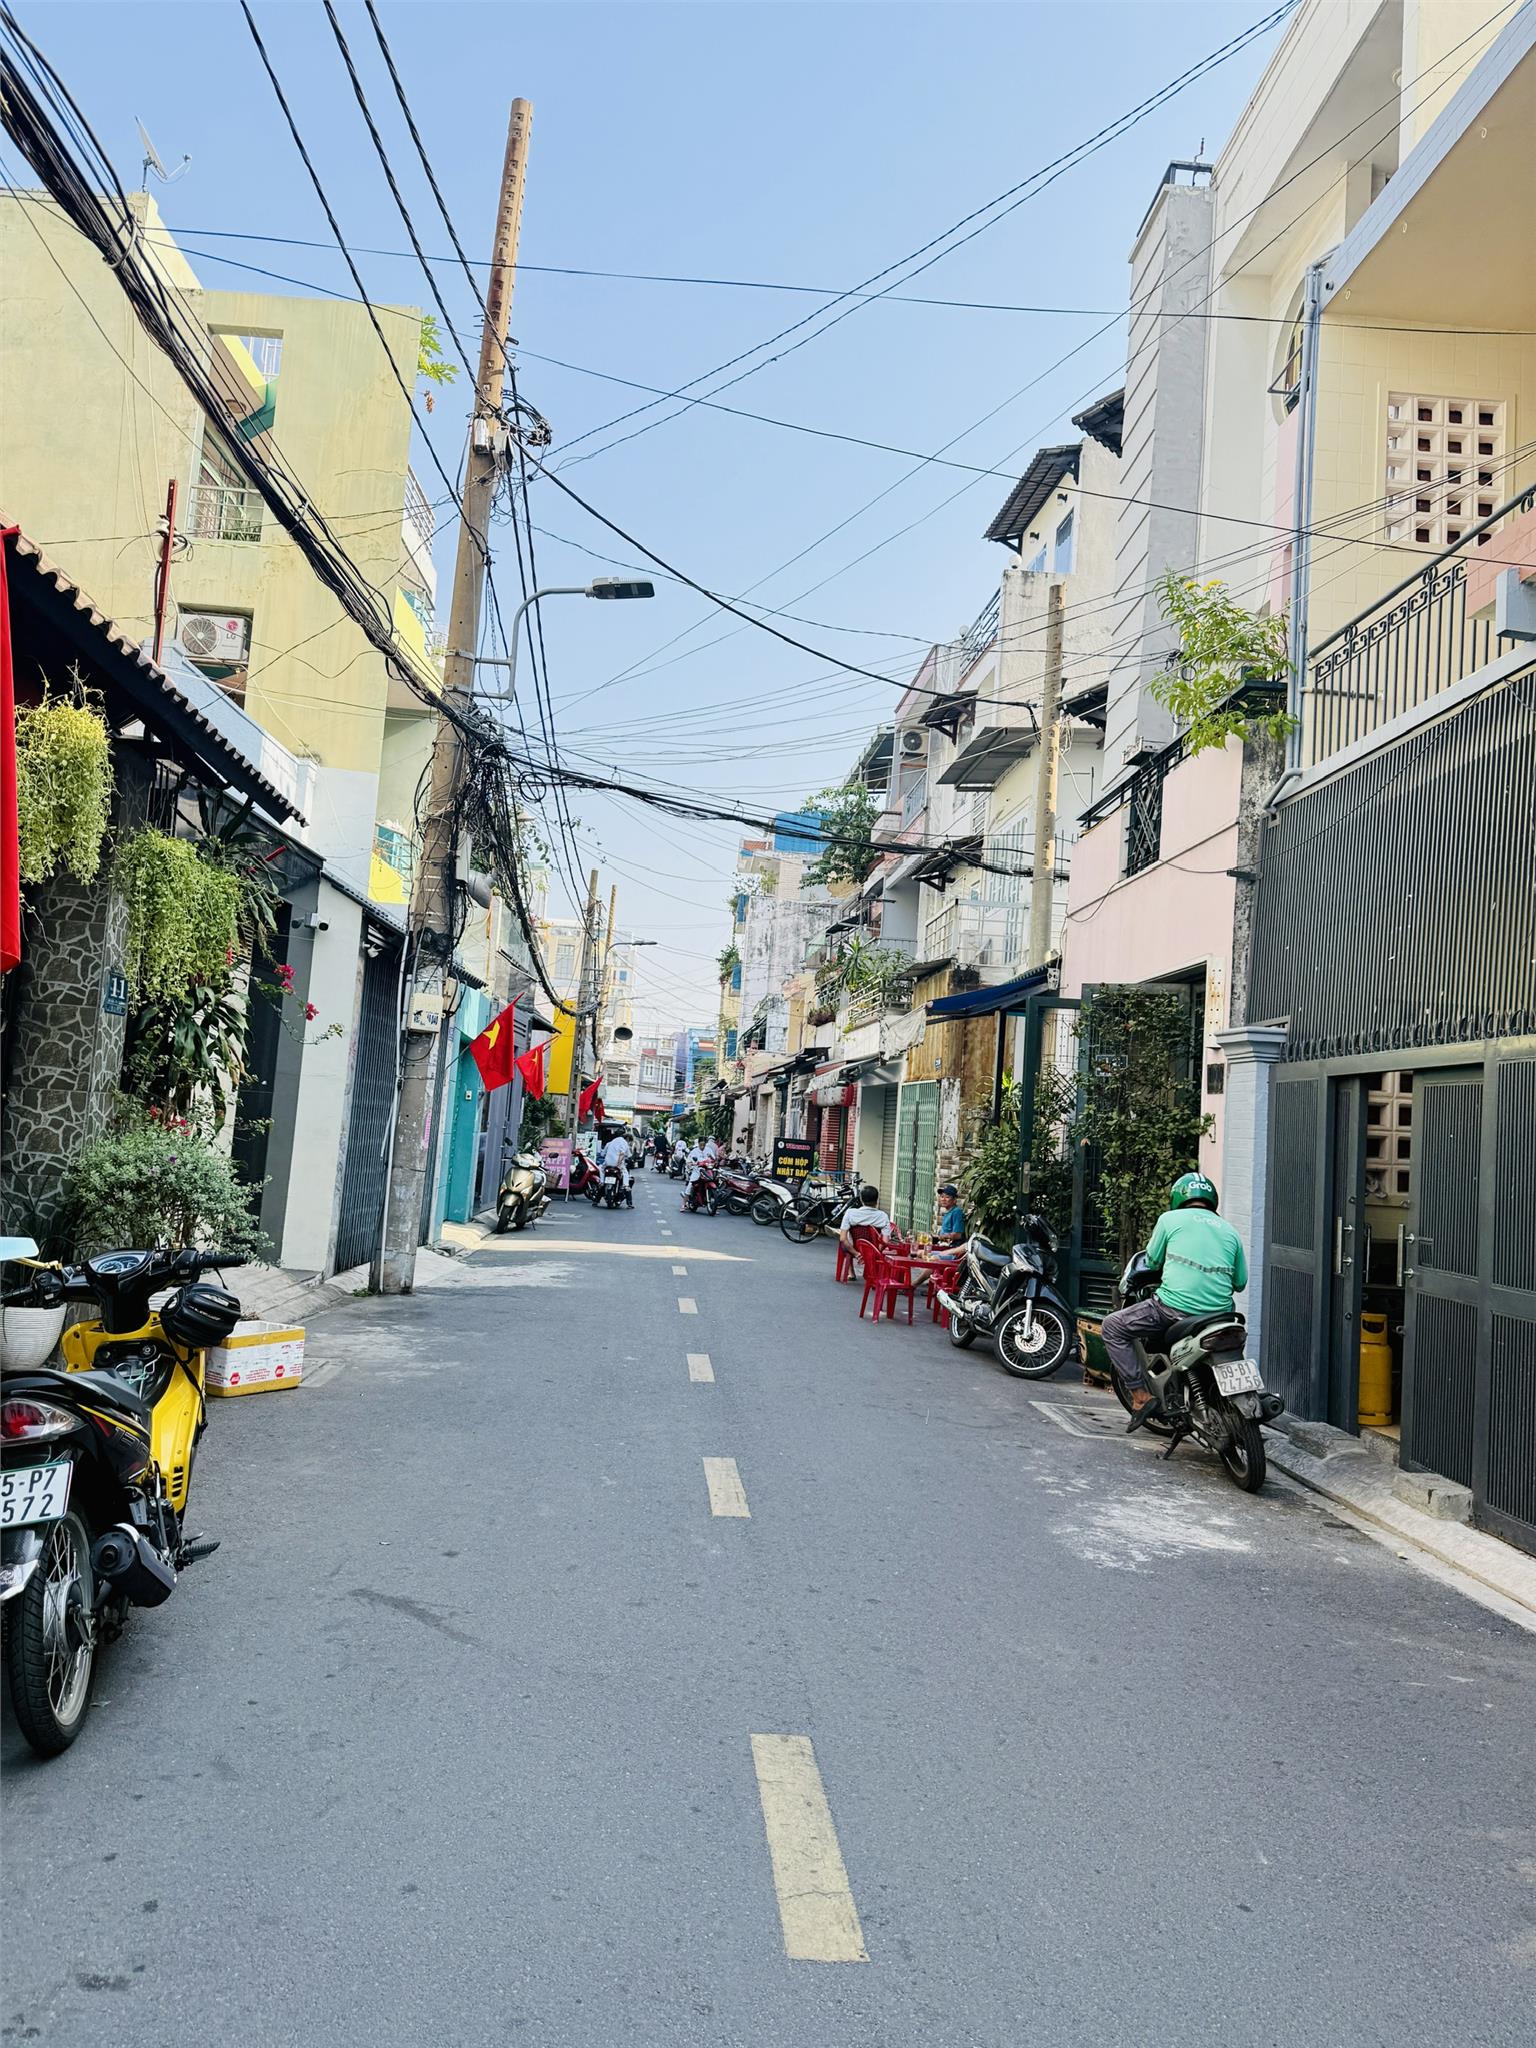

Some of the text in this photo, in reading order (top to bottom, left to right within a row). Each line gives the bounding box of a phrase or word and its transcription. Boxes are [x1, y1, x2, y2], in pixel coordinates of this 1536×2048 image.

[111, 977, 125, 999] 11
[1189, 1181, 1212, 1192] Grab
[0, 1467, 57, 1496] 5-P7
